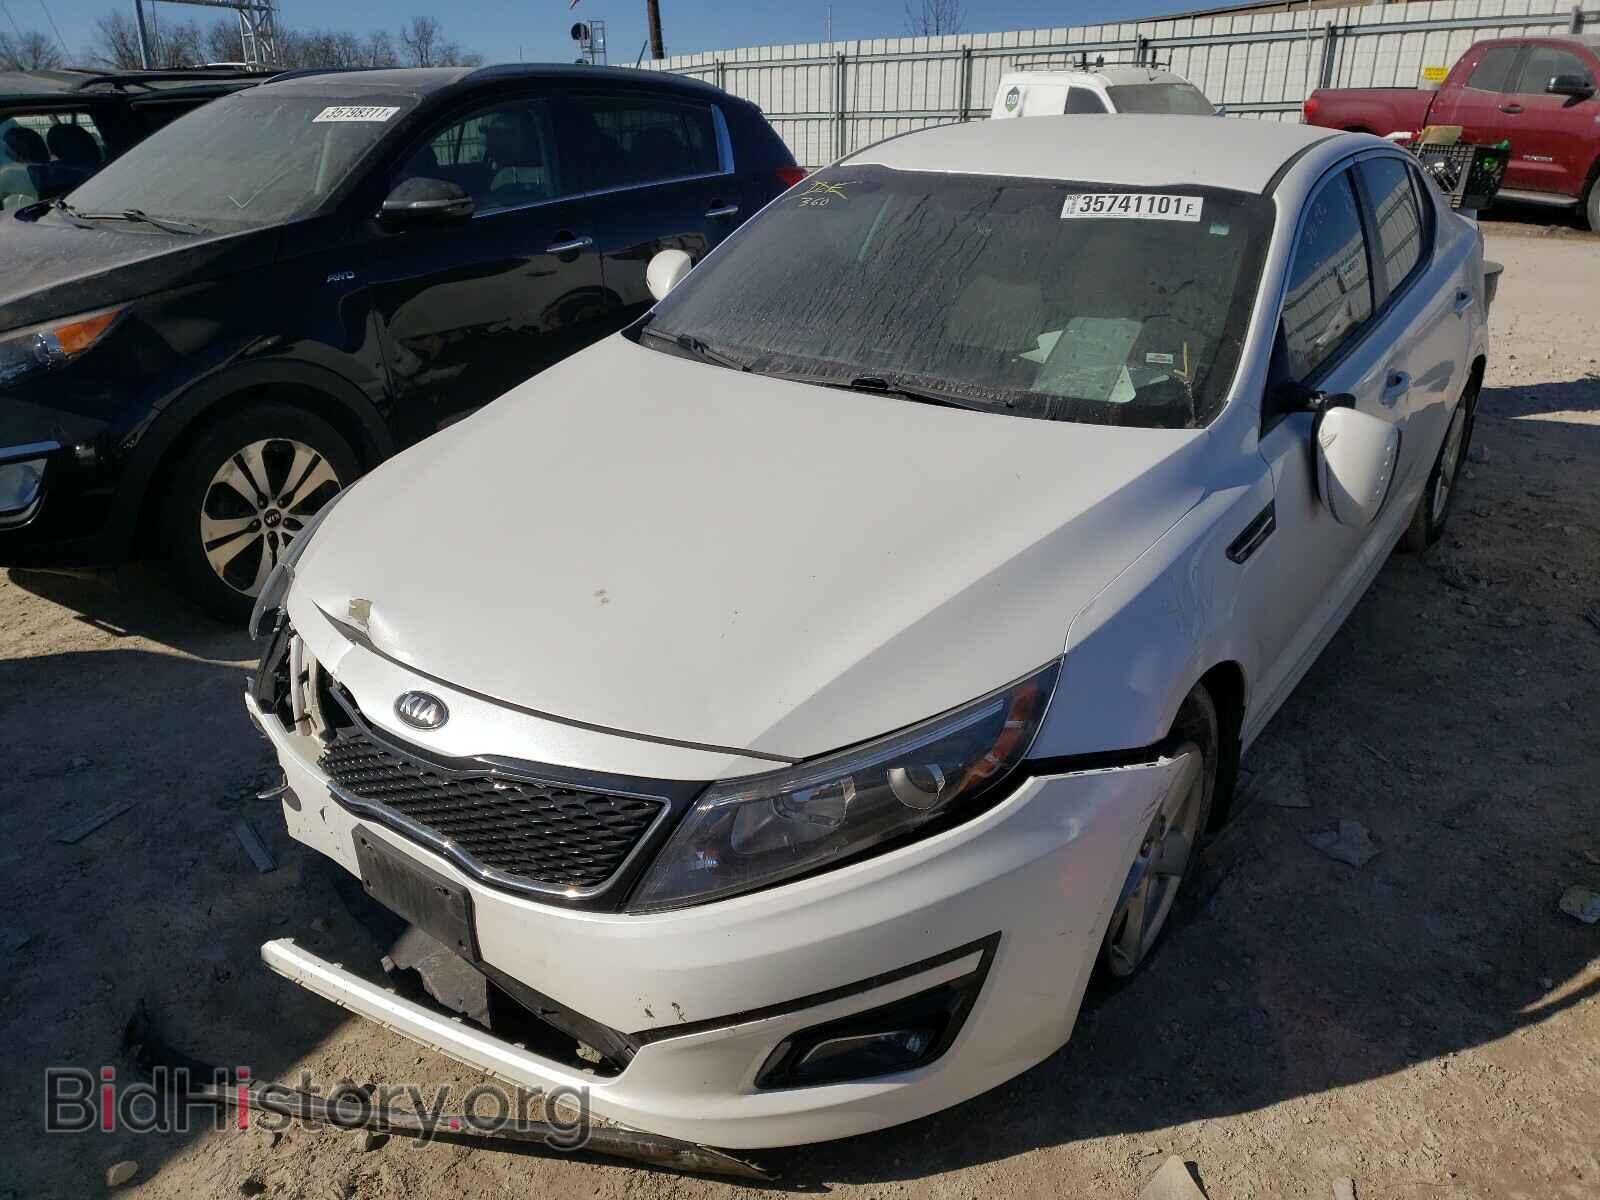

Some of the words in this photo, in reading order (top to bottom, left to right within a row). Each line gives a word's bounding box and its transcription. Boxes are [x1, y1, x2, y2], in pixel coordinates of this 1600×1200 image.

[1079, 195, 1182, 214] 35741101
[1185, 203, 1194, 213] F
[327, 271, 355, 282] AWD
[399, 693, 438, 725] KIA
